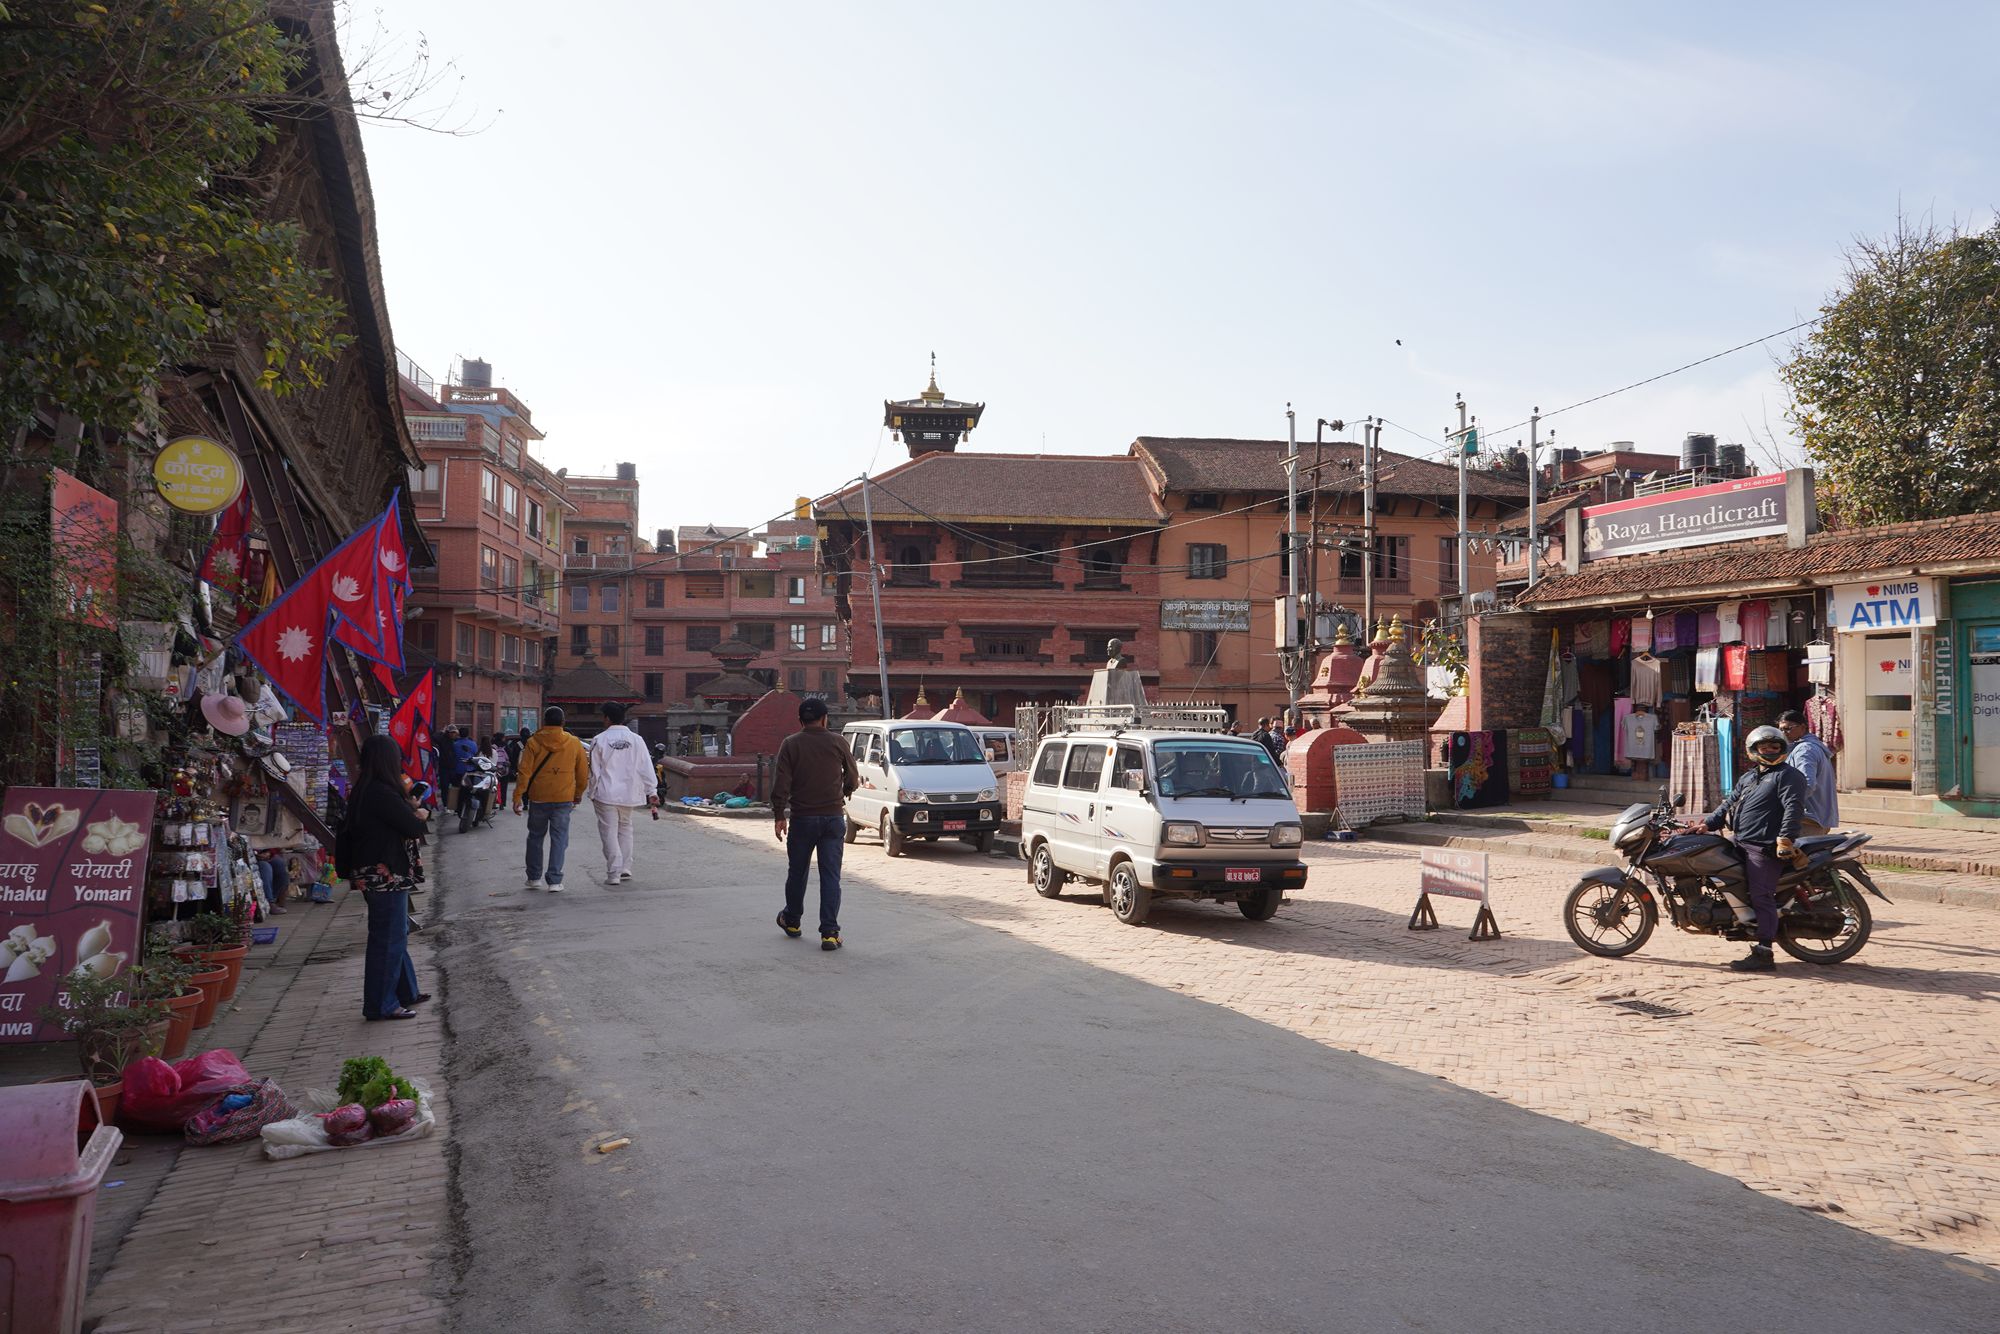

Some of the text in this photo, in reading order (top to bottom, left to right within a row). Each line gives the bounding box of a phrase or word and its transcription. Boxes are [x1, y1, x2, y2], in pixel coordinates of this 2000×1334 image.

[1606, 497, 1779, 542] Raya Handicraft
[1883, 582, 1919, 596] NIMB
[1849, 597, 1921, 629] ATM
[1898, 659, 1912, 669] NI
[1974, 692, 2000, 702] Bhak
[1974, 705, 2000, 717] Digit
[71, 858, 133, 880] योमारी
[1424, 866, 1481, 883] PARKING
[74, 885, 133, 901] Yomari
[0, 993, 25, 1012] वा
[0, 1022, 33, 1036] uwa
